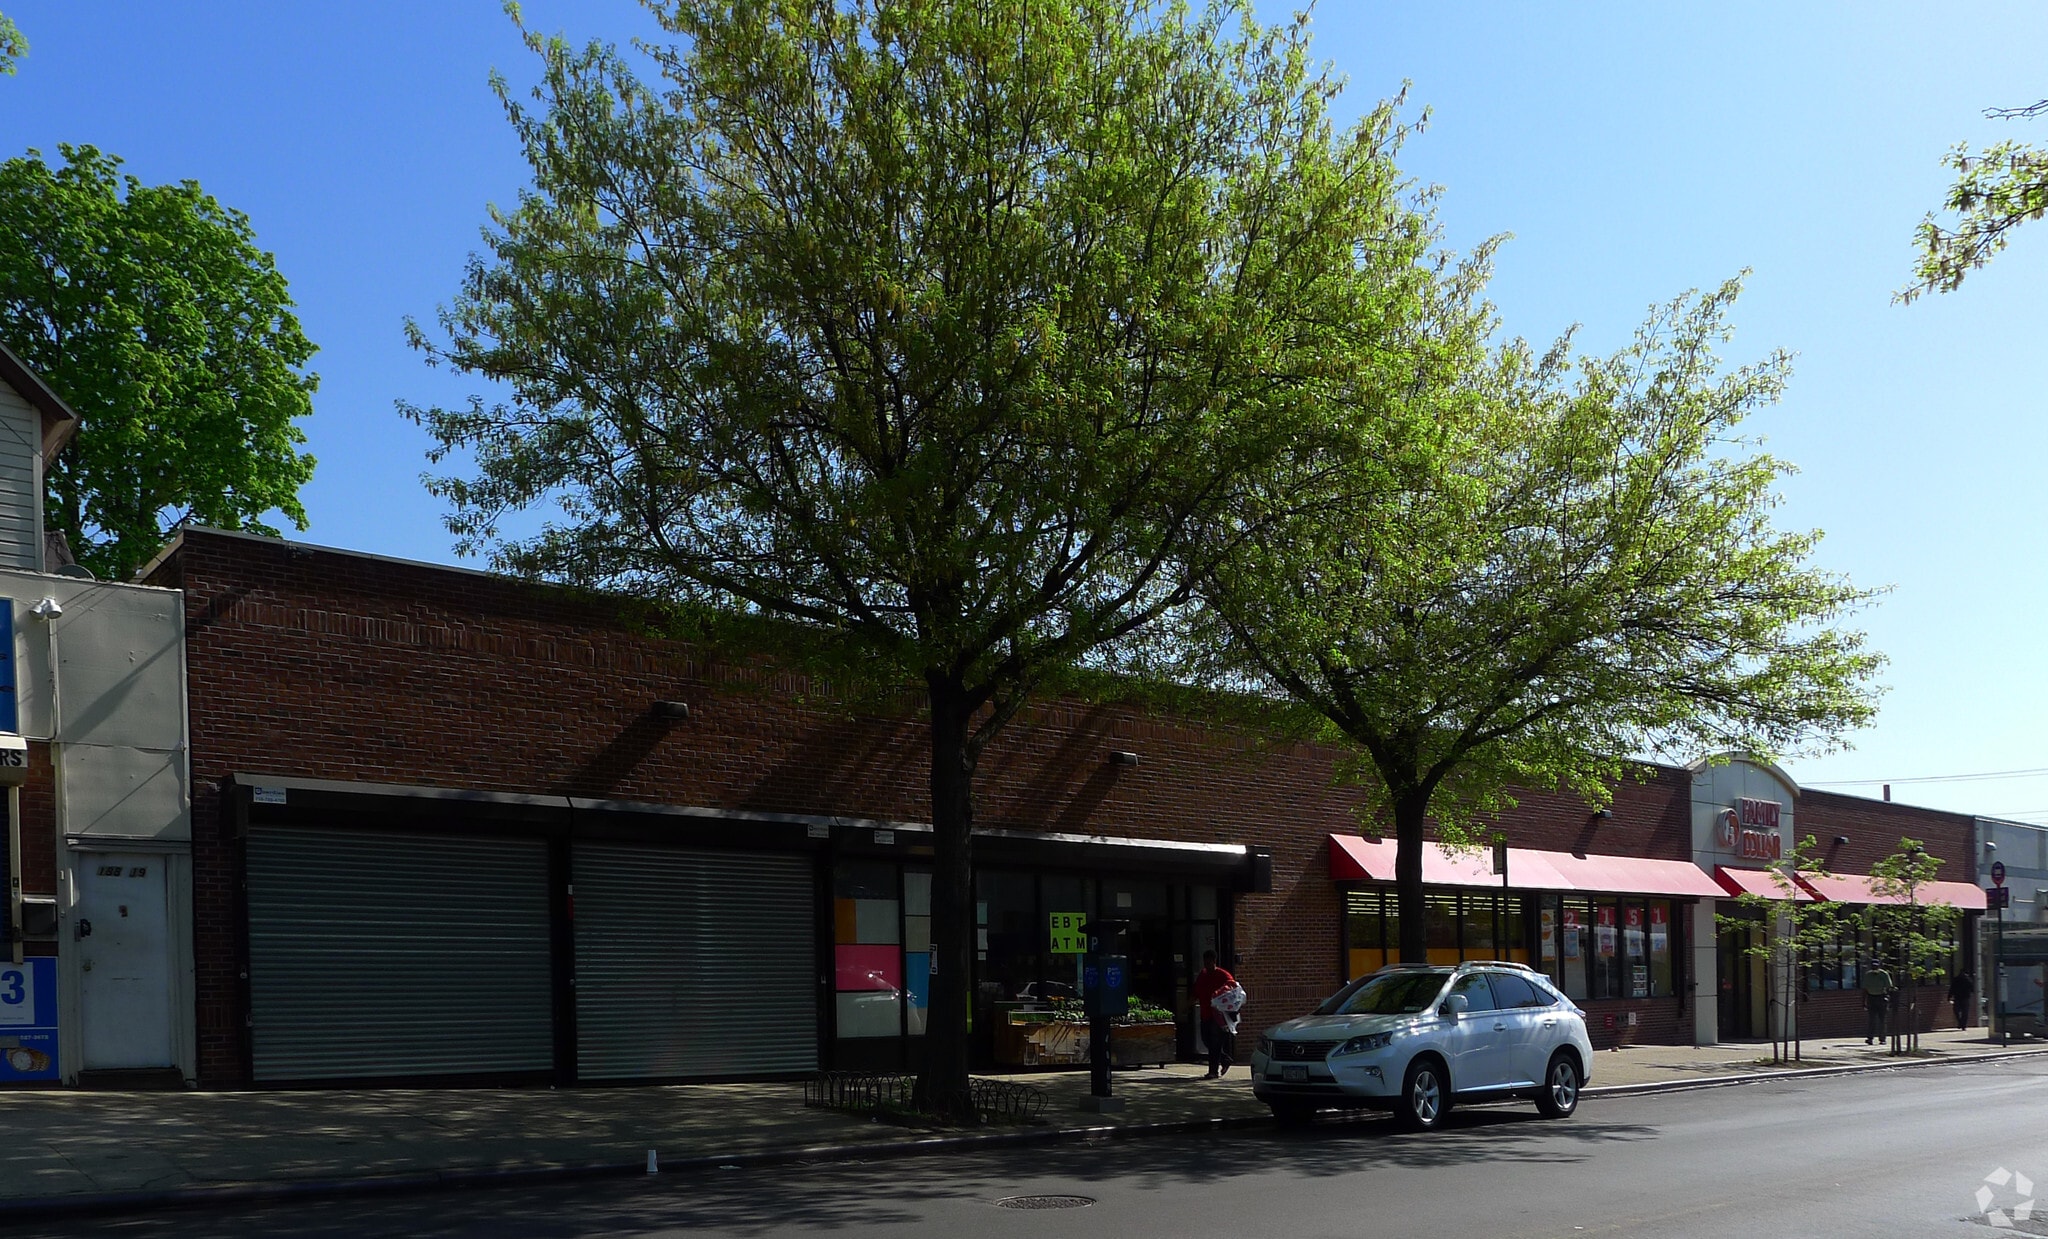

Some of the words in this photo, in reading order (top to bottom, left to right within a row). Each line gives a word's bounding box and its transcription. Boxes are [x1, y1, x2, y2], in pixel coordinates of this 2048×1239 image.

[1741, 796, 1782, 827] FAMILY
[1742, 830, 1782, 860] DOLLAR
[97, 866, 123, 877] 188
[1052, 917, 1083, 928] EBT
[1052, 937, 1086, 949] ATM
